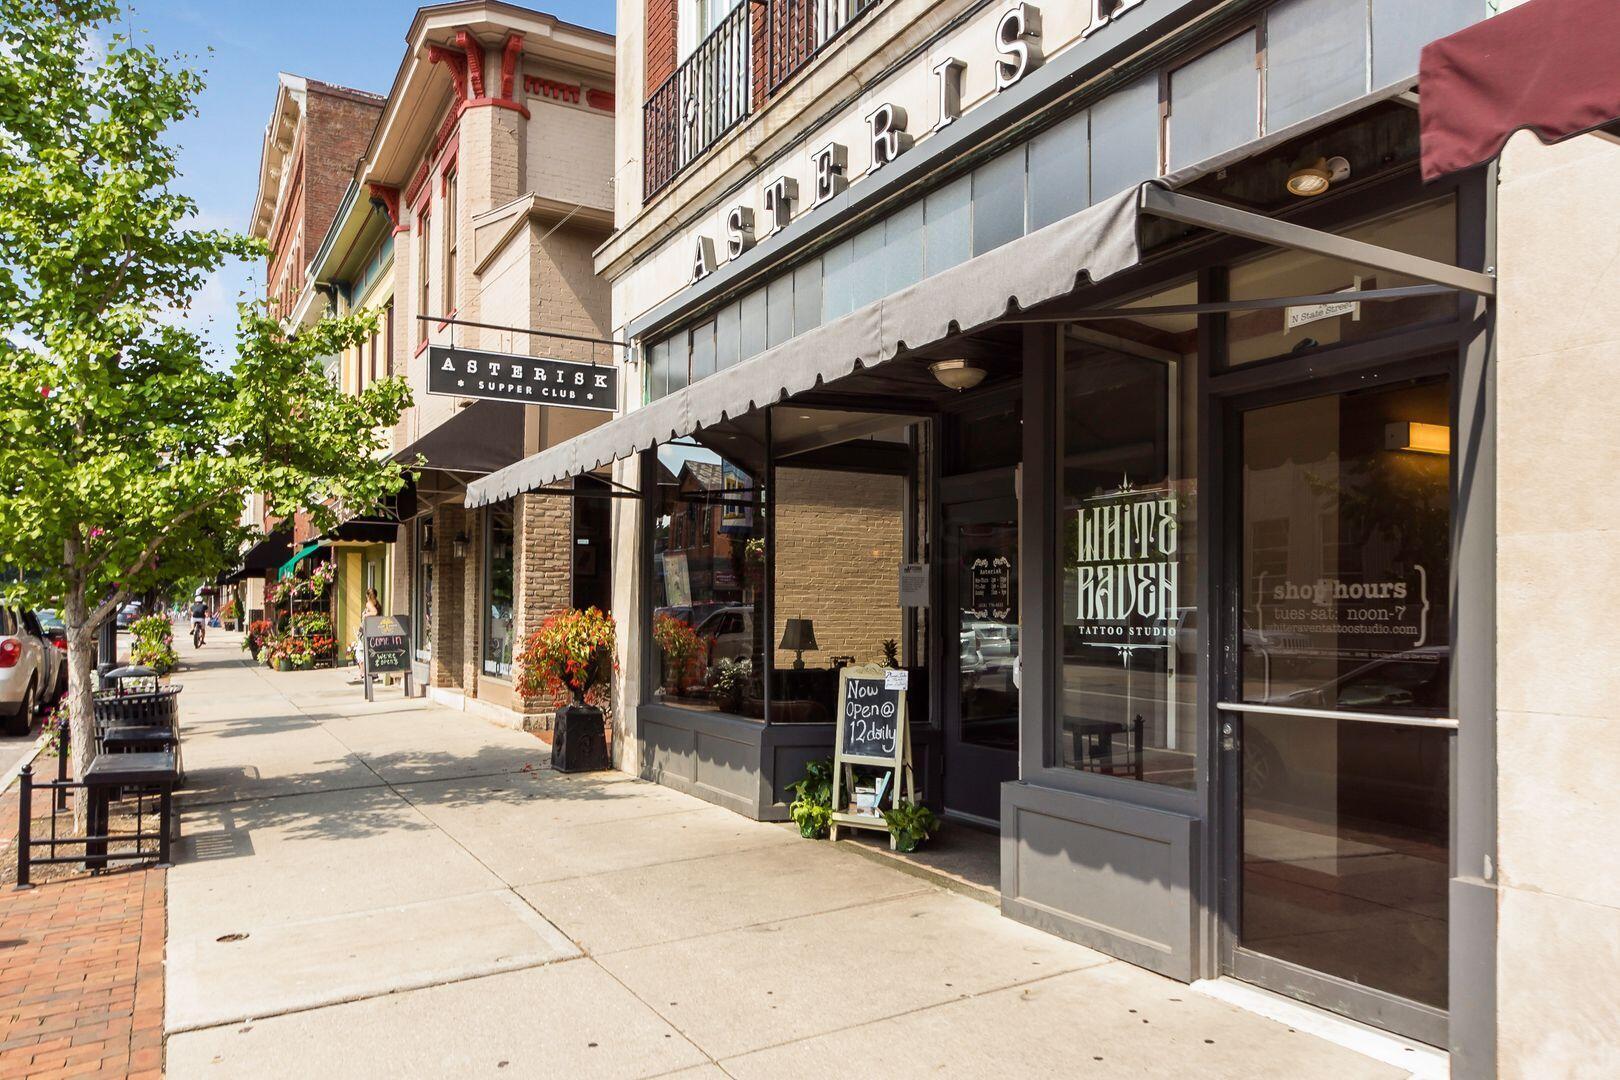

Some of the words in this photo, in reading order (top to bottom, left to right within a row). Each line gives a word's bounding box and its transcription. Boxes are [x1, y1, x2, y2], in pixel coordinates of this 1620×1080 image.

[1292, 314, 1299, 323] N
[1300, 310, 1325, 321] State
[441, 357, 608, 388] ASTERISK
[478, 380, 533, 395] SUPPER
[542, 387, 576, 399] CLUB
[1077, 500, 1178, 561] WHITE
[1077, 562, 1179, 620] RAVEN
[1333, 579, 1407, 599] hours
[1274, 607, 1338, 620] tues-sat:
[1347, 606, 1406, 621] noon-7
[1079, 626, 1123, 636] TATTOO
[1129, 626, 1177, 637] STUDIO
[847, 680, 879, 699] Now
